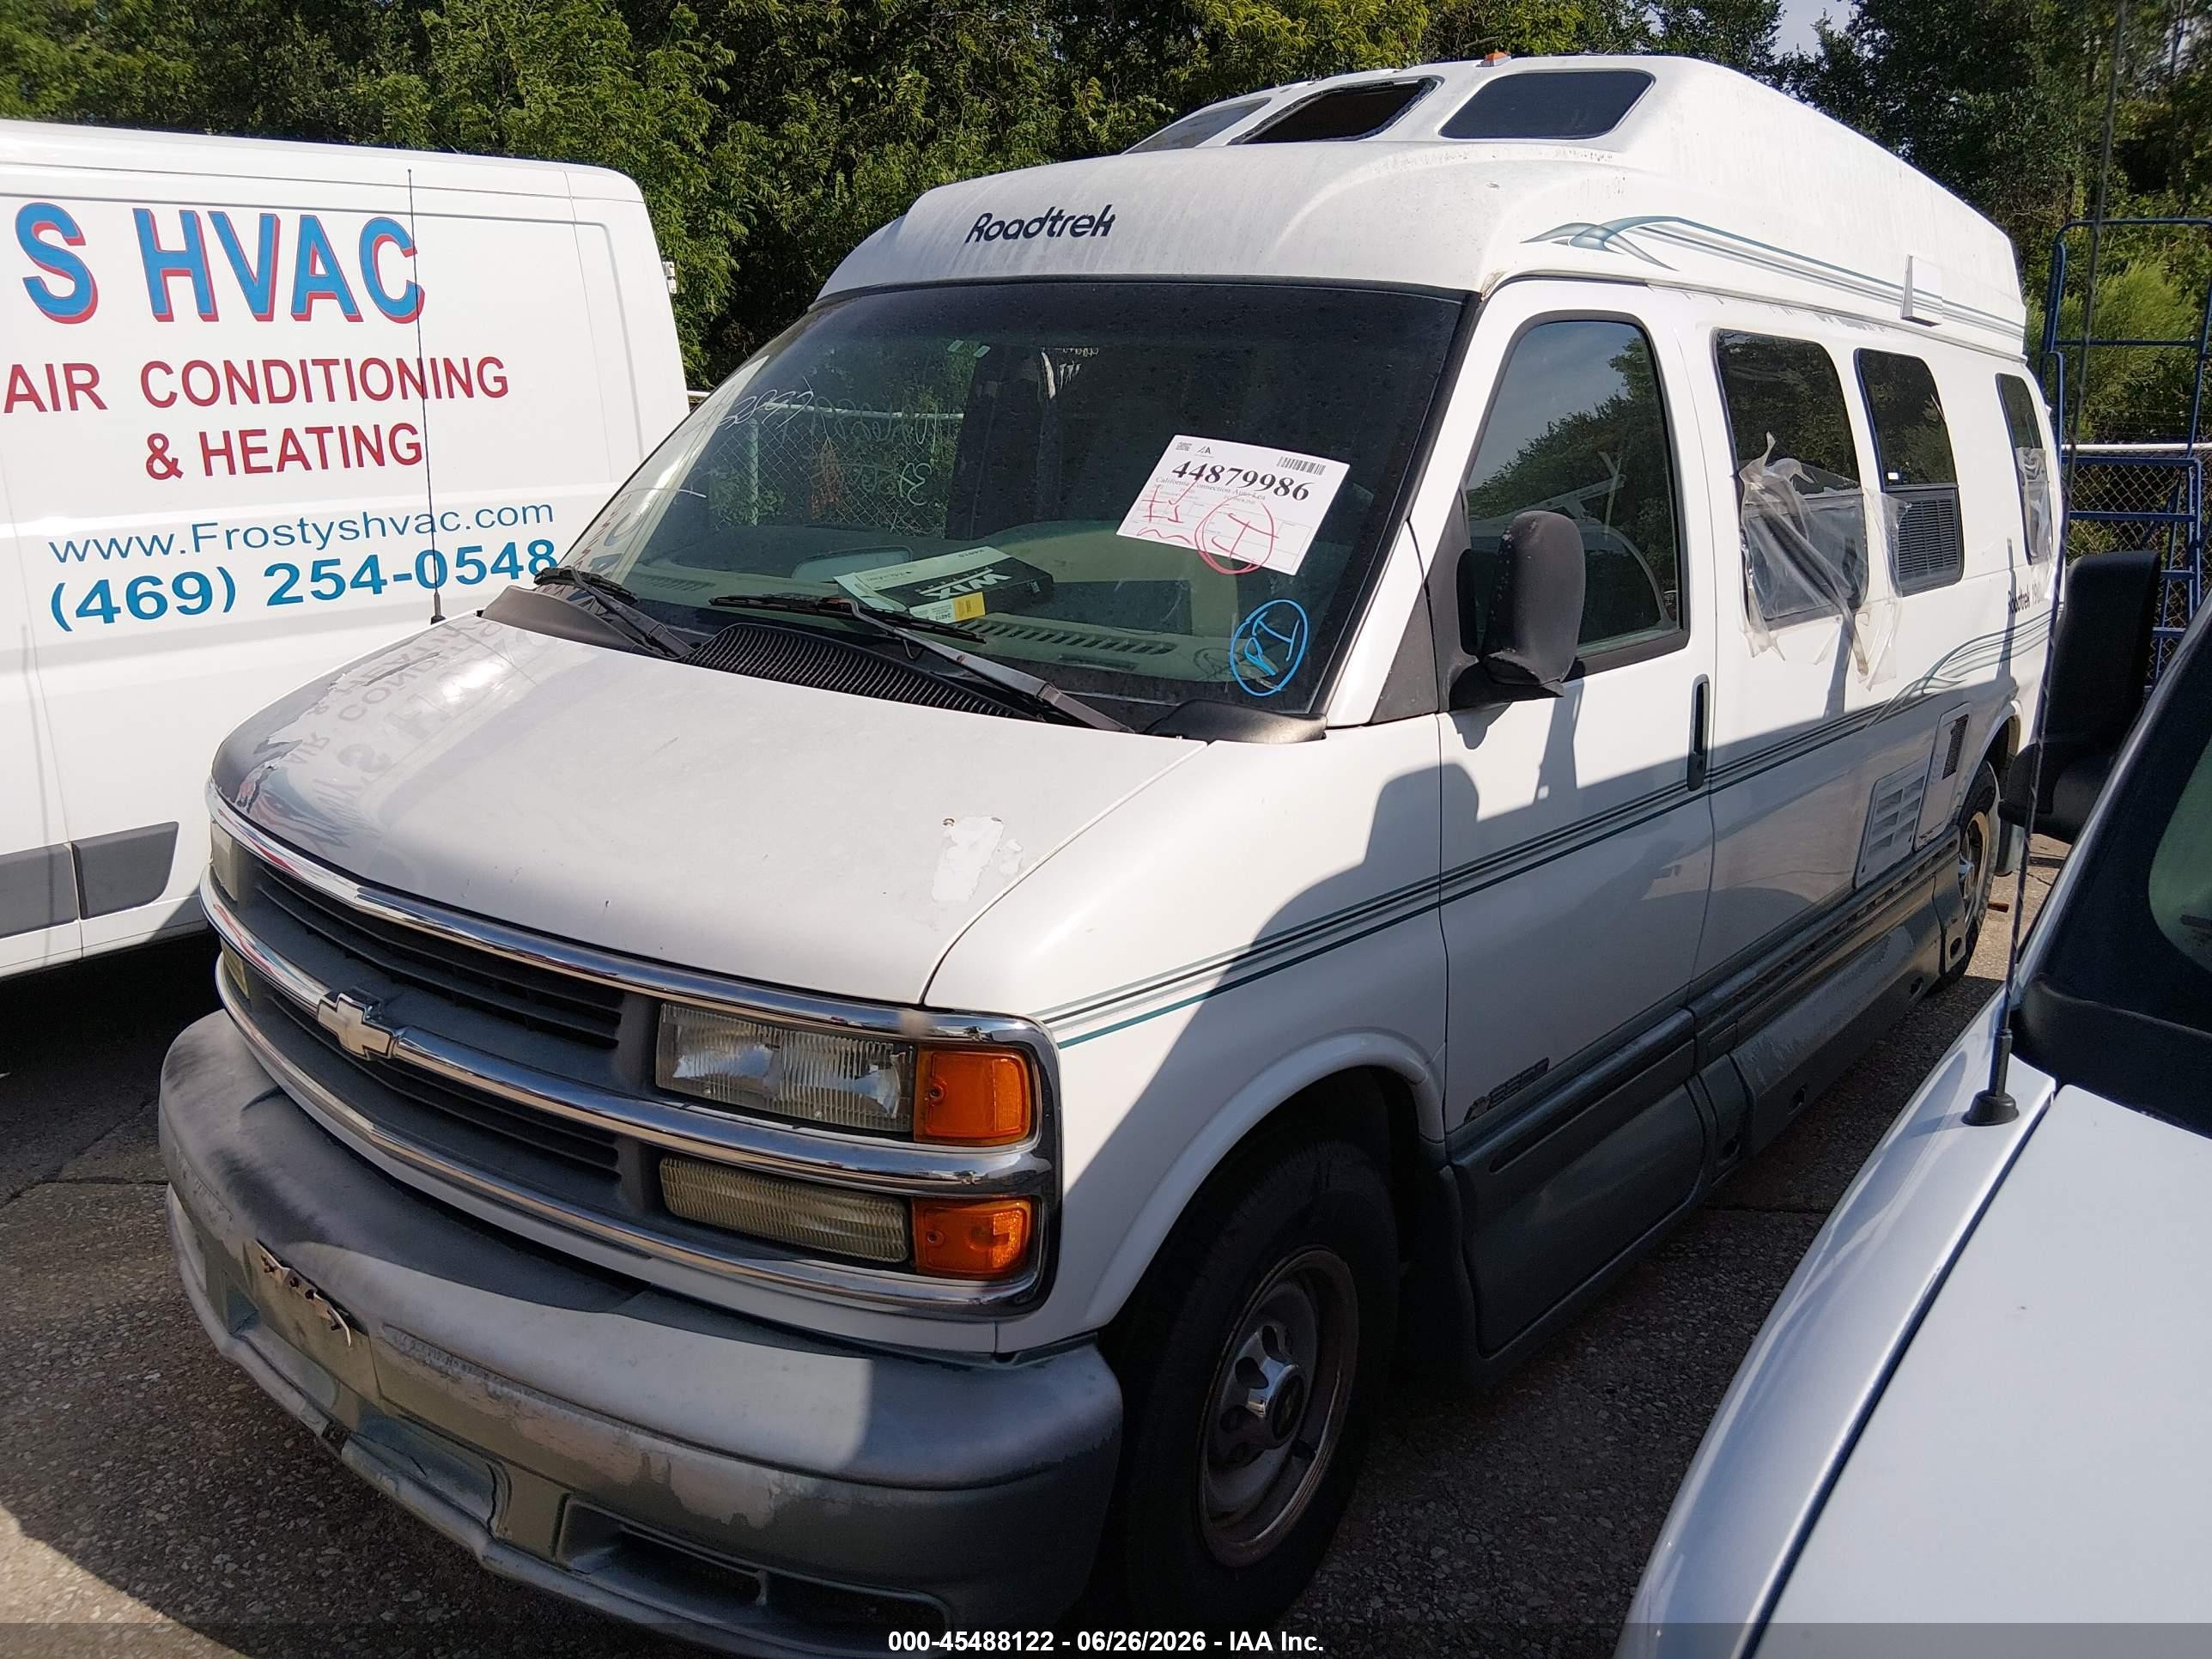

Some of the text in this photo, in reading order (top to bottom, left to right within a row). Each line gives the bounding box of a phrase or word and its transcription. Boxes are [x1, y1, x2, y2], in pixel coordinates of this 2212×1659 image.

[965, 204, 1116, 244] Roadtrek
[15, 202, 425, 324] S HVAC
[3, 356, 508, 413] AIR CONDITIONING
[145, 422, 423, 481] & HEATING
[1171, 460, 1316, 501] 44879986
[49, 504, 554, 563] www.Frostyshvac.com
[51, 566, 236, 631] (469)
[264, 538, 559, 606] 254-0548
[924, 573, 1012, 600] WIX
